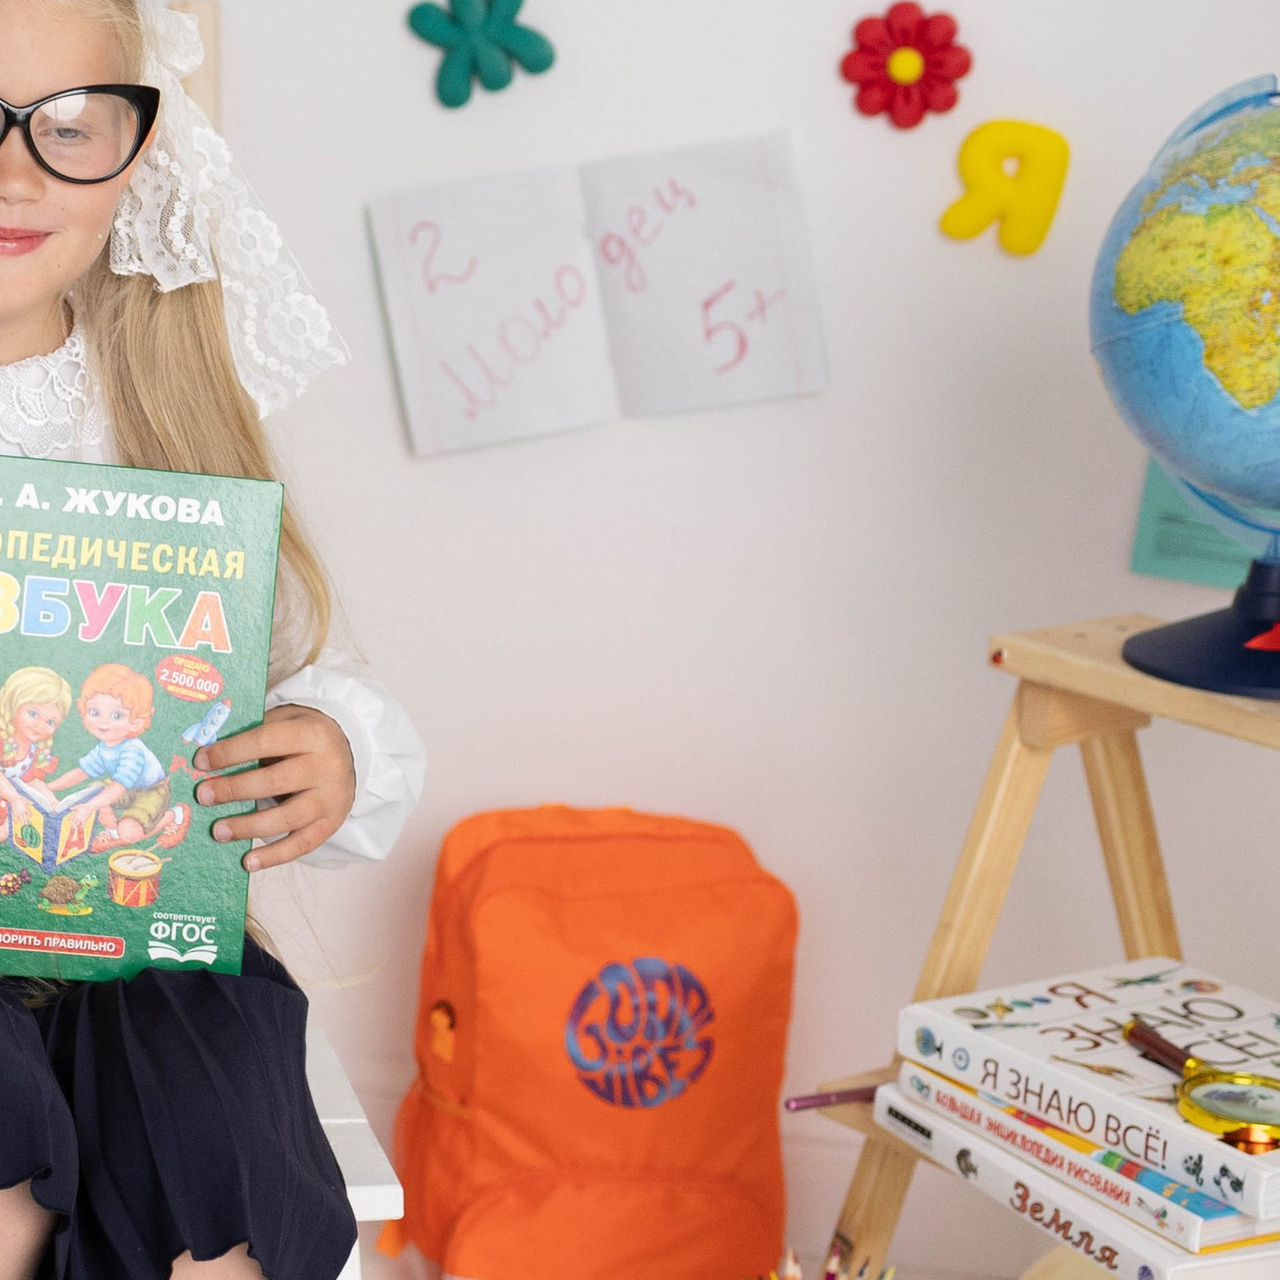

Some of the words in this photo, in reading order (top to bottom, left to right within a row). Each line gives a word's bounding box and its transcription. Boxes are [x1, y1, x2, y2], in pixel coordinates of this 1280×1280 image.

[939, 119, 1071, 258] Я
[408, 219, 478, 293] 2
[16, 482, 50, 510] А.
[64, 486, 225, 527] ЖУКОВА
[160, 669, 220, 695] 2.500.000
[149, 921, 216, 945] ФГОС
[153, 911, 217, 924] соответствует
[44, 936, 116, 953] ПРАВИЛЬНО
[1047, 981, 1117, 1010] Я
[981, 1058, 998, 1090] Я
[1006, 1068, 1096, 1134] ЗНАЮ
[1104, 1113, 1168, 1169] ВСЁ!
[985, 1116, 1066, 1171] ЭНЦИКЛОПЕДИЯ
[1068, 1161, 1132, 1206] РИСОВАНИЯ
[1009, 1180, 1119, 1270] Земля
